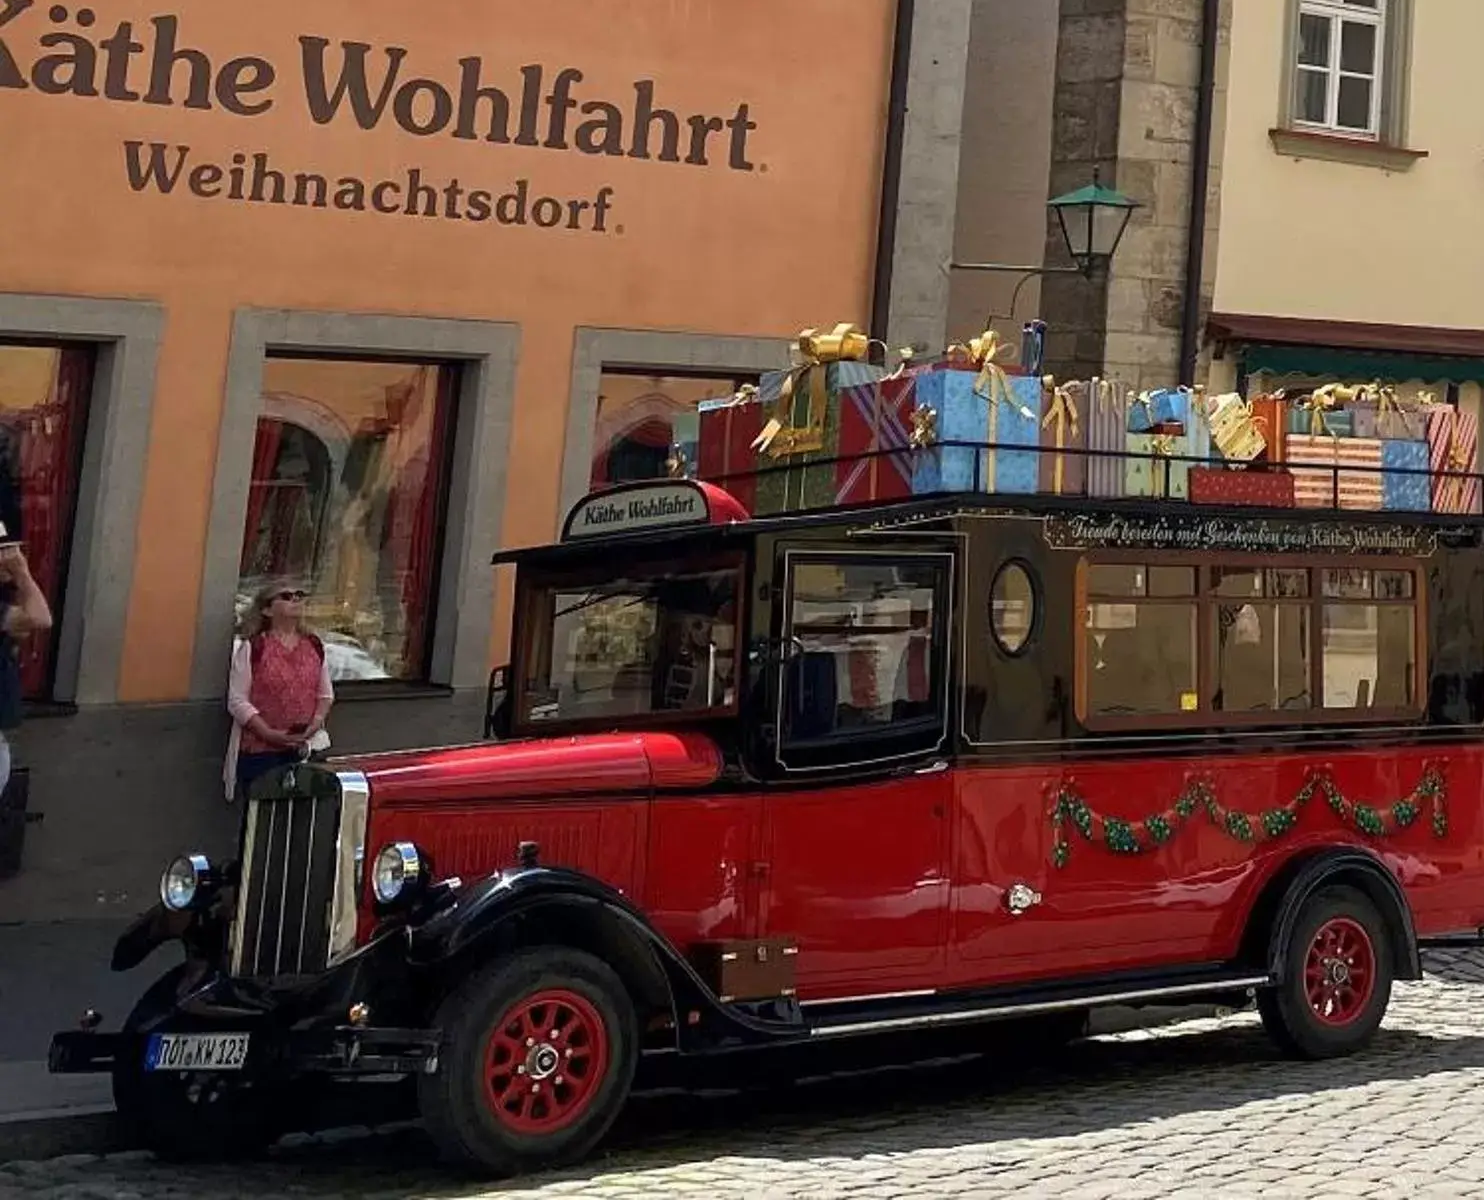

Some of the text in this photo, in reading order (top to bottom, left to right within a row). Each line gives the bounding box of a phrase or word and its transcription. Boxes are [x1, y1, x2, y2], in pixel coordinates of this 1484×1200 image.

[583, 494, 695, 526] Käthe Wohlfahrt
[1312, 524, 1351, 547] Käthe
[1352, 525, 1418, 548] Wohlfahrt
